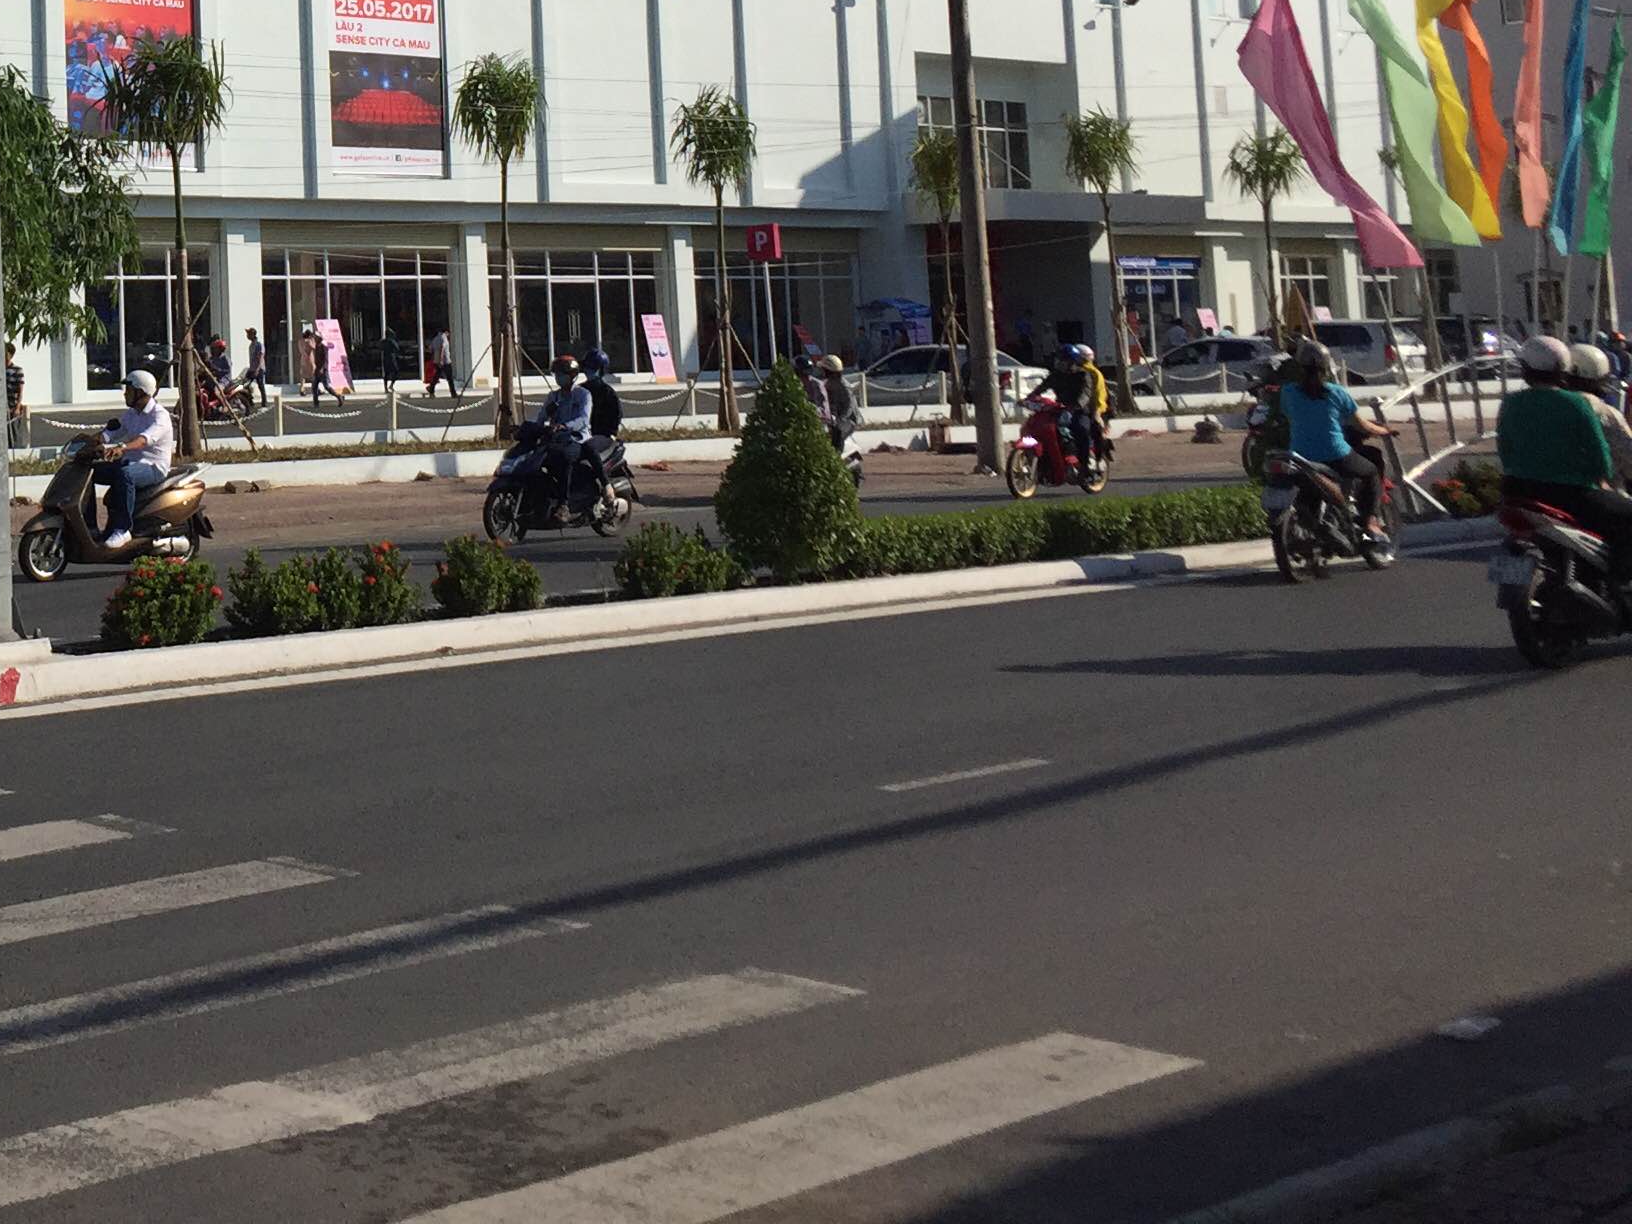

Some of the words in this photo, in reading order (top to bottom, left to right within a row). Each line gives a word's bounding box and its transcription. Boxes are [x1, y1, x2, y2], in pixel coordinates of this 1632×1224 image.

[335, 34, 367, 46] SENSE
[368, 36, 391, 47] CITY
[408, 39, 431, 50] MAU
[755, 231, 768, 252] P
